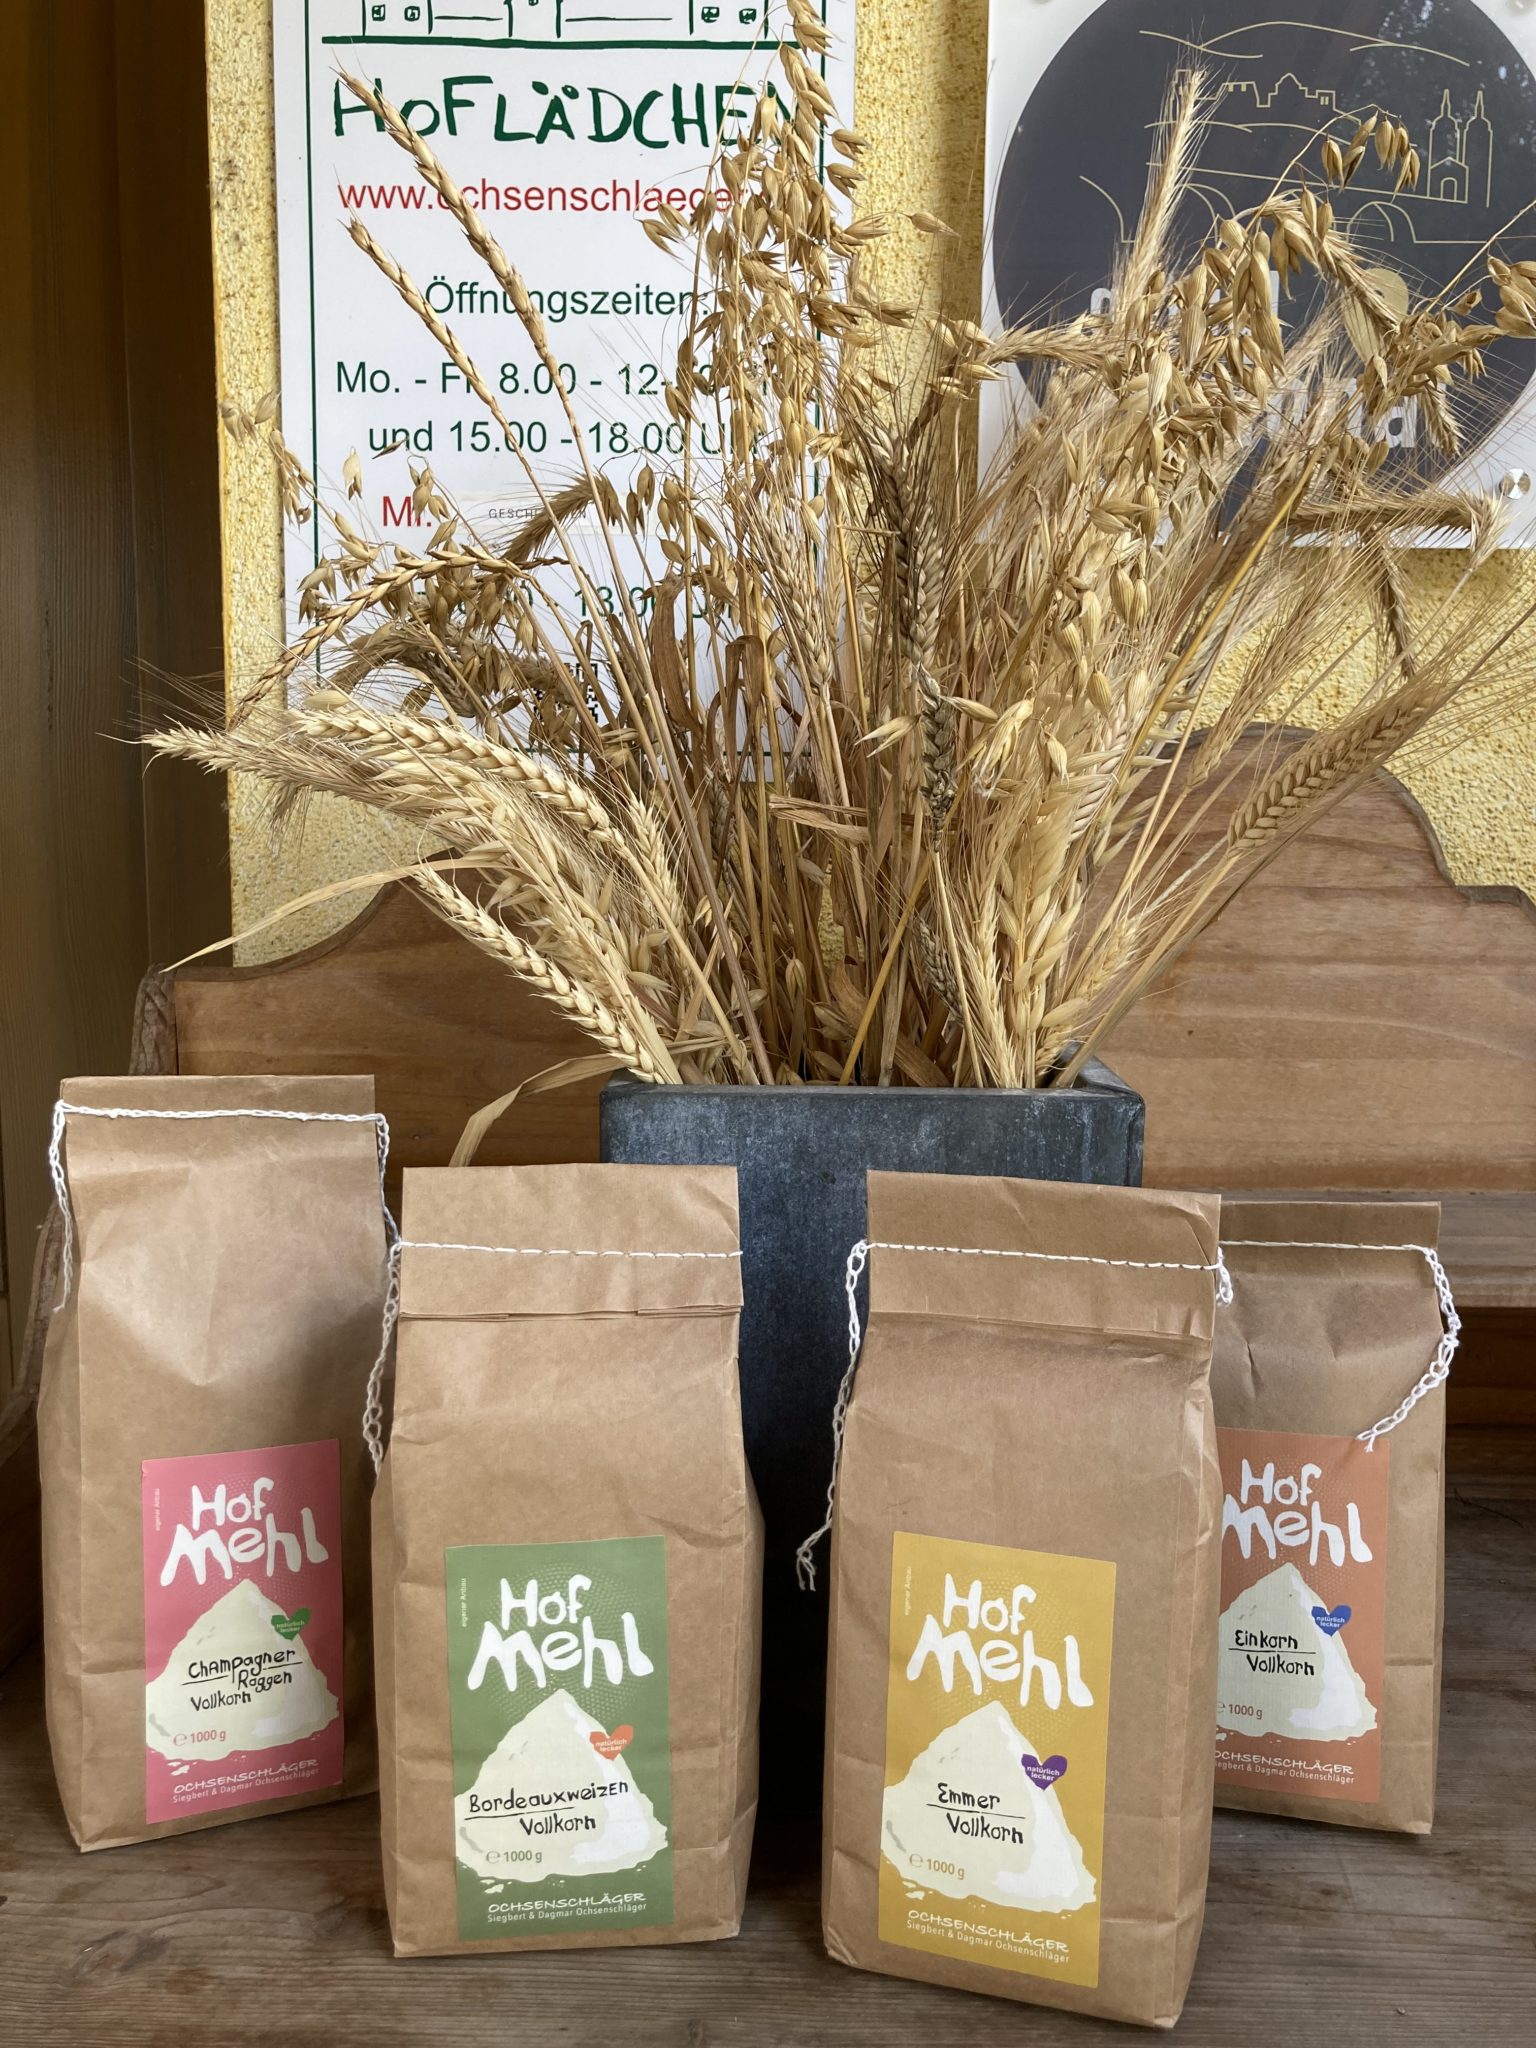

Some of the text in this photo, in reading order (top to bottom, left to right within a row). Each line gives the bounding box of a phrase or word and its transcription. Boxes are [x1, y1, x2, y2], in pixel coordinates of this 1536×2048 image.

[337, 361, 400, 393] Mo.
[500, 362, 576, 395] 8.00
[369, 420, 432, 452] und
[450, 421, 547, 453] 15.00
[589, 421, 686, 454] 18.00
[1241, 1458, 1322, 1506] Hof
[192, 1477, 274, 1531] Hof
[1222, 1493, 1373, 1567] Mehl
[160, 1507, 329, 1587] Mehl
[500, 1574, 592, 1630] Hof
[942, 1573, 1036, 1635] Hof
[467, 1611, 654, 1692] Mehl
[1235, 1629, 1298, 1650] Einkorn
[906, 1614, 1094, 1710] Mehl
[1246, 1654, 1315, 1676] Vollkorn
[190, 1690, 252, 1712] Vollkorn
[1228, 1704, 1254, 1717] 1000
[1256, 1709, 1263, 1720] g
[190, 1730, 218, 1744] 1000
[220, 1731, 227, 1742] g
[173, 1759, 319, 1794] OCHSENSCHLÄGER
[1026, 1766, 1060, 1776] natürlich
[1031, 1772, 1055, 1781] lecker
[1215, 1761, 1354, 1785] iegbert & Dagmar Ochsenschläger
[172, 1789, 209, 1803] Siegbert
[220, 1781, 252, 1794] Dagmar
[469, 1781, 629, 1813] Bordeauxweizen
[937, 1782, 1001, 1809] Emmer
[519, 1812, 596, 1836] Vollkorn
[946, 1812, 1024, 1844] Vollkorn
[503, 1850, 533, 1863] 1000
[536, 1852, 542, 1863] g
[927, 1858, 955, 1875] 1000
[958, 1868, 965, 1880] g
[487, 1903, 647, 1923] Siegbert & Dagmar Ochsenschläger
[488, 1892, 647, 1913] OCHSENSCHLÄGER
[906, 1920, 1070, 1963] Siegbert & Dagmar Ochsenschläger
[908, 1909, 1070, 1953] OCHSENSCHLÄGER
